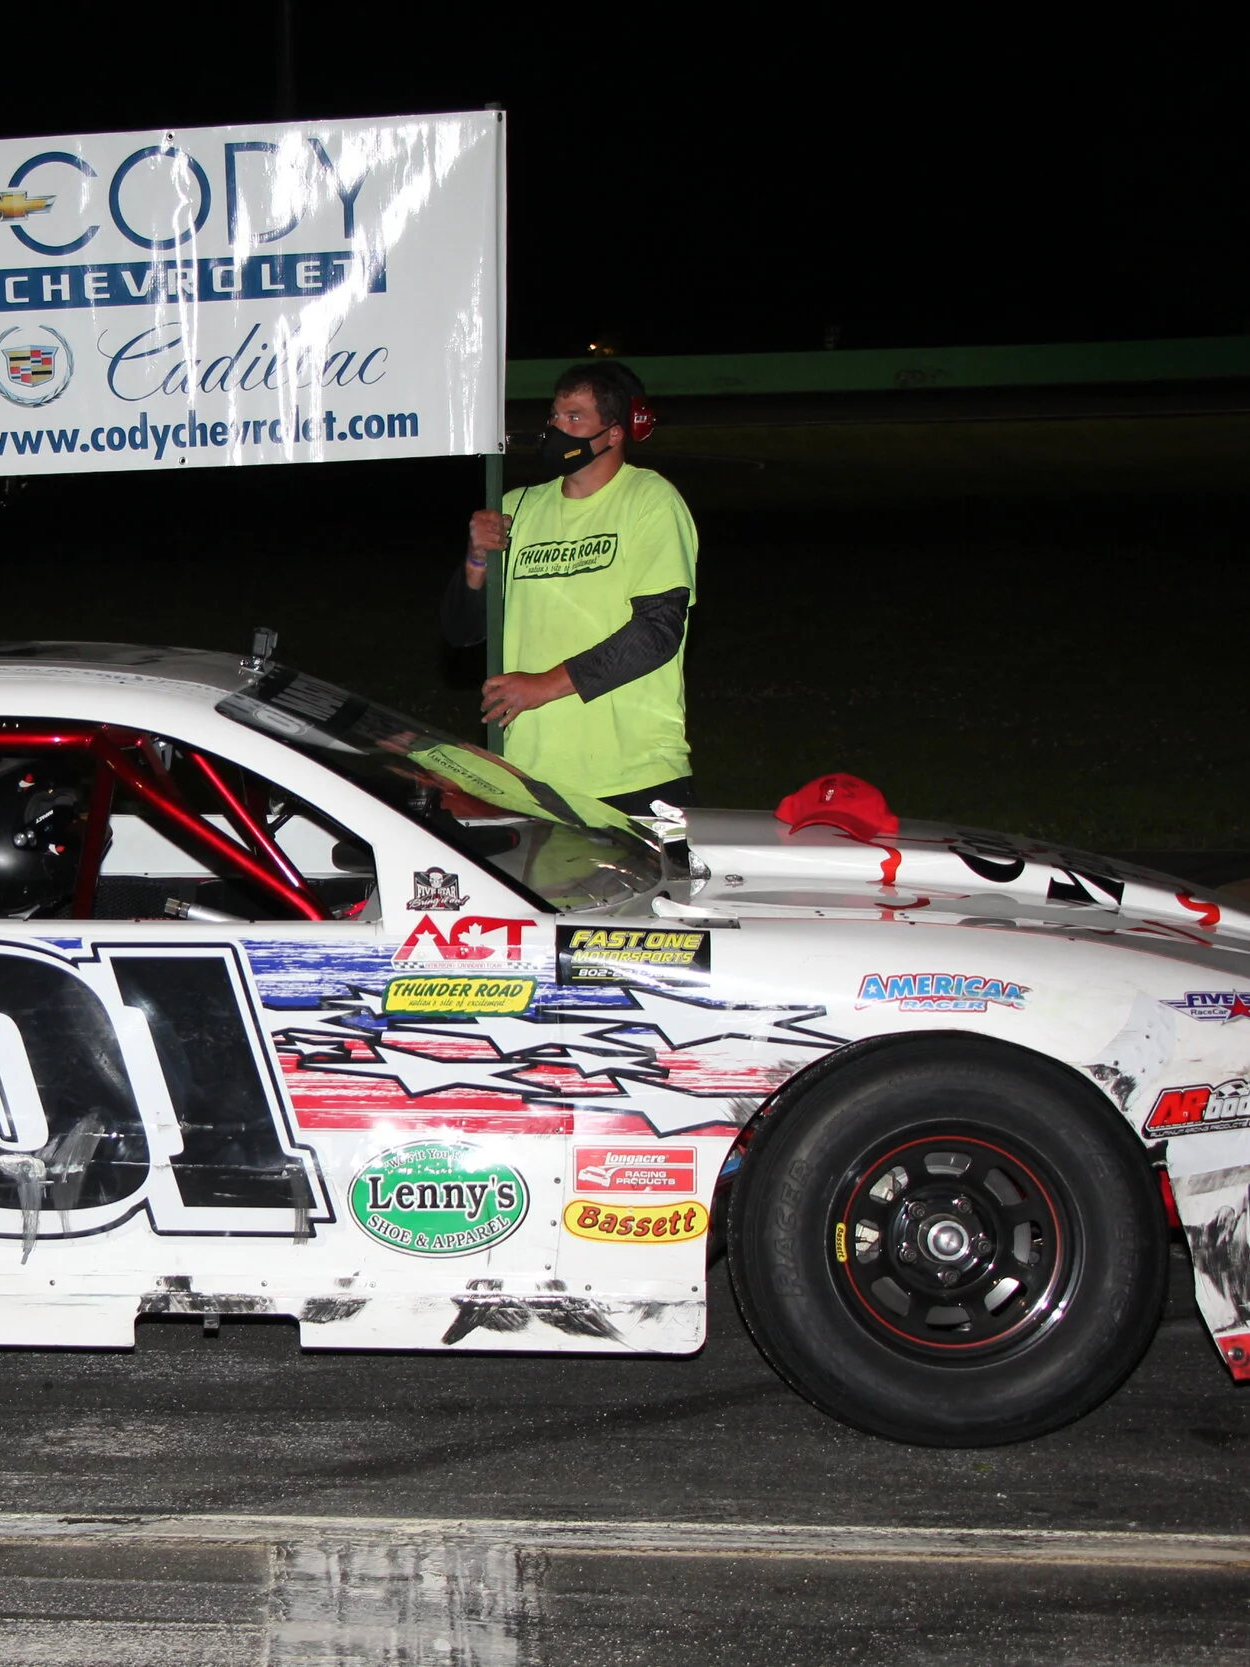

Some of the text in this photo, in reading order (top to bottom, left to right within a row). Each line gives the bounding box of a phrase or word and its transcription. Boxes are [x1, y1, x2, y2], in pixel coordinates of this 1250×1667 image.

[6, 137, 372, 256] CODY
[4, 258, 361, 305] CHEVROLET
[519, 539, 612, 566] THUNDER ROAD
[393, 913, 538, 960] ACT
[569, 929, 704, 951] FAST ONE
[571, 949, 695, 964] MOTORSPORTS
[393, 983, 523, 997] THUNDER ROAD
[1186, 993, 1234, 1007] FIVE
[902, 1001, 985, 1010] RACER
[1190, 1008, 1229, 1016] RaceCar
[1149, 1088, 1211, 1127] AR
[605, 1152, 666, 1165] Longacre
[366, 1175, 517, 1220] Lenny's
[368, 1215, 510, 1249] SHOE & APPAREL
[577, 1206, 697, 1237] Bassett
